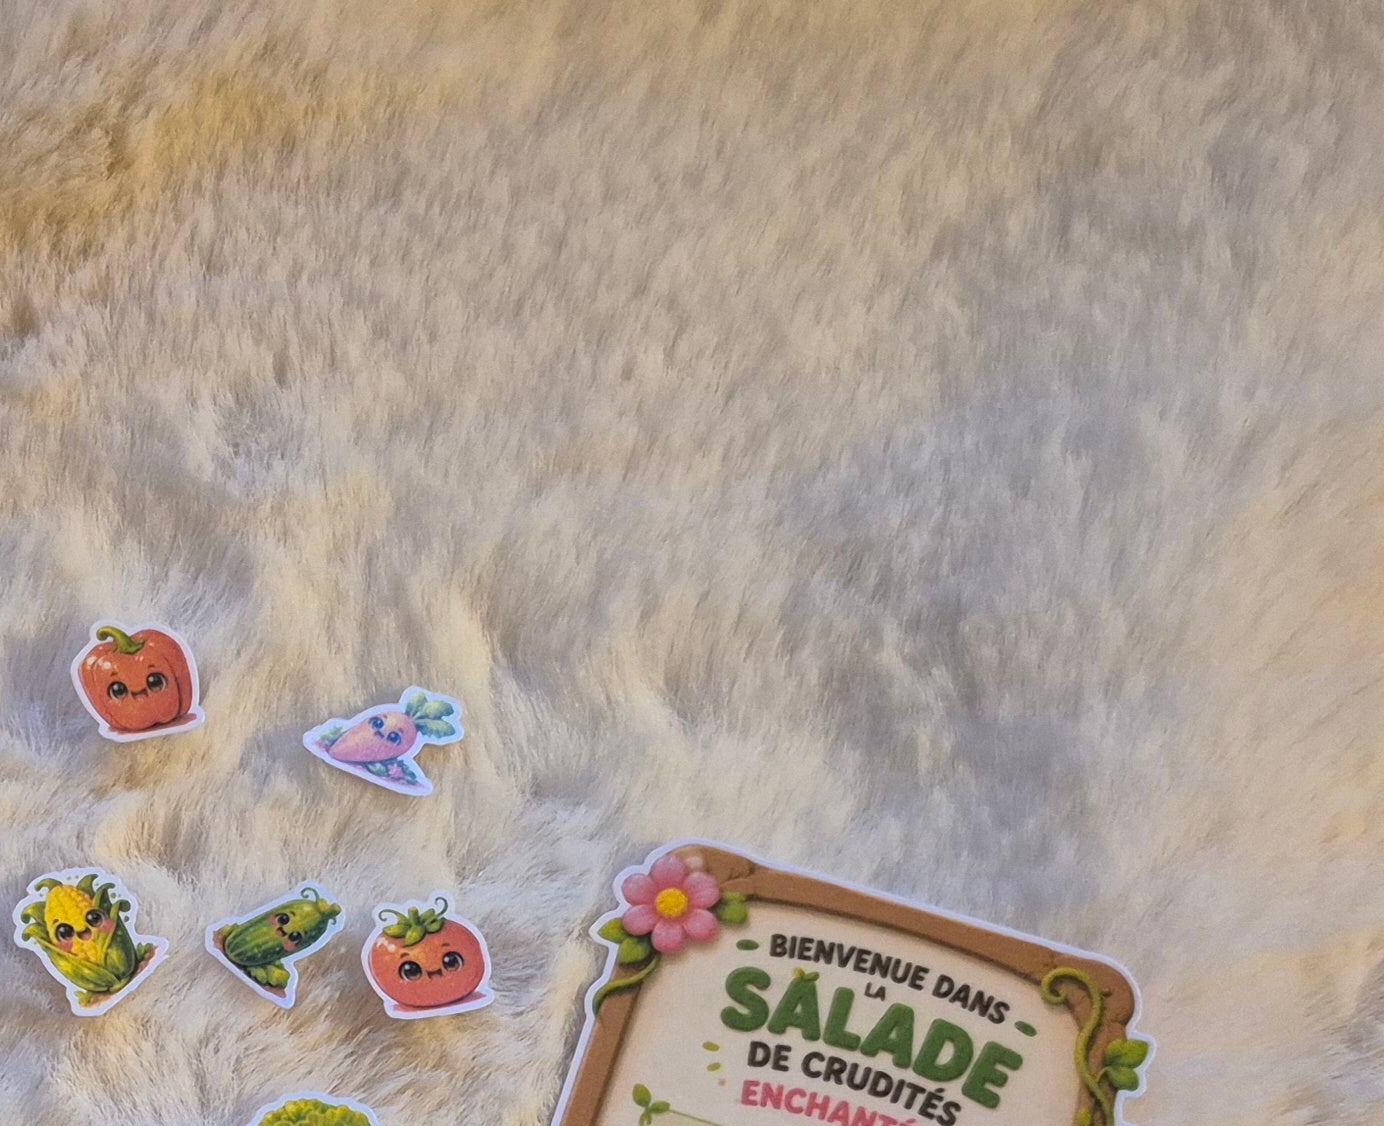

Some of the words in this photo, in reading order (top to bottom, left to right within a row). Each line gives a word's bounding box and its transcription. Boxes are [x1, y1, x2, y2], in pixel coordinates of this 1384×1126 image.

[769, 934, 929, 991] BIENVENUE
[934, 975, 1011, 1025] DANS
[864, 982, 887, 1001] LA
[720, 965, 1024, 1109] SALADE
[747, 1041, 792, 1072] DE
